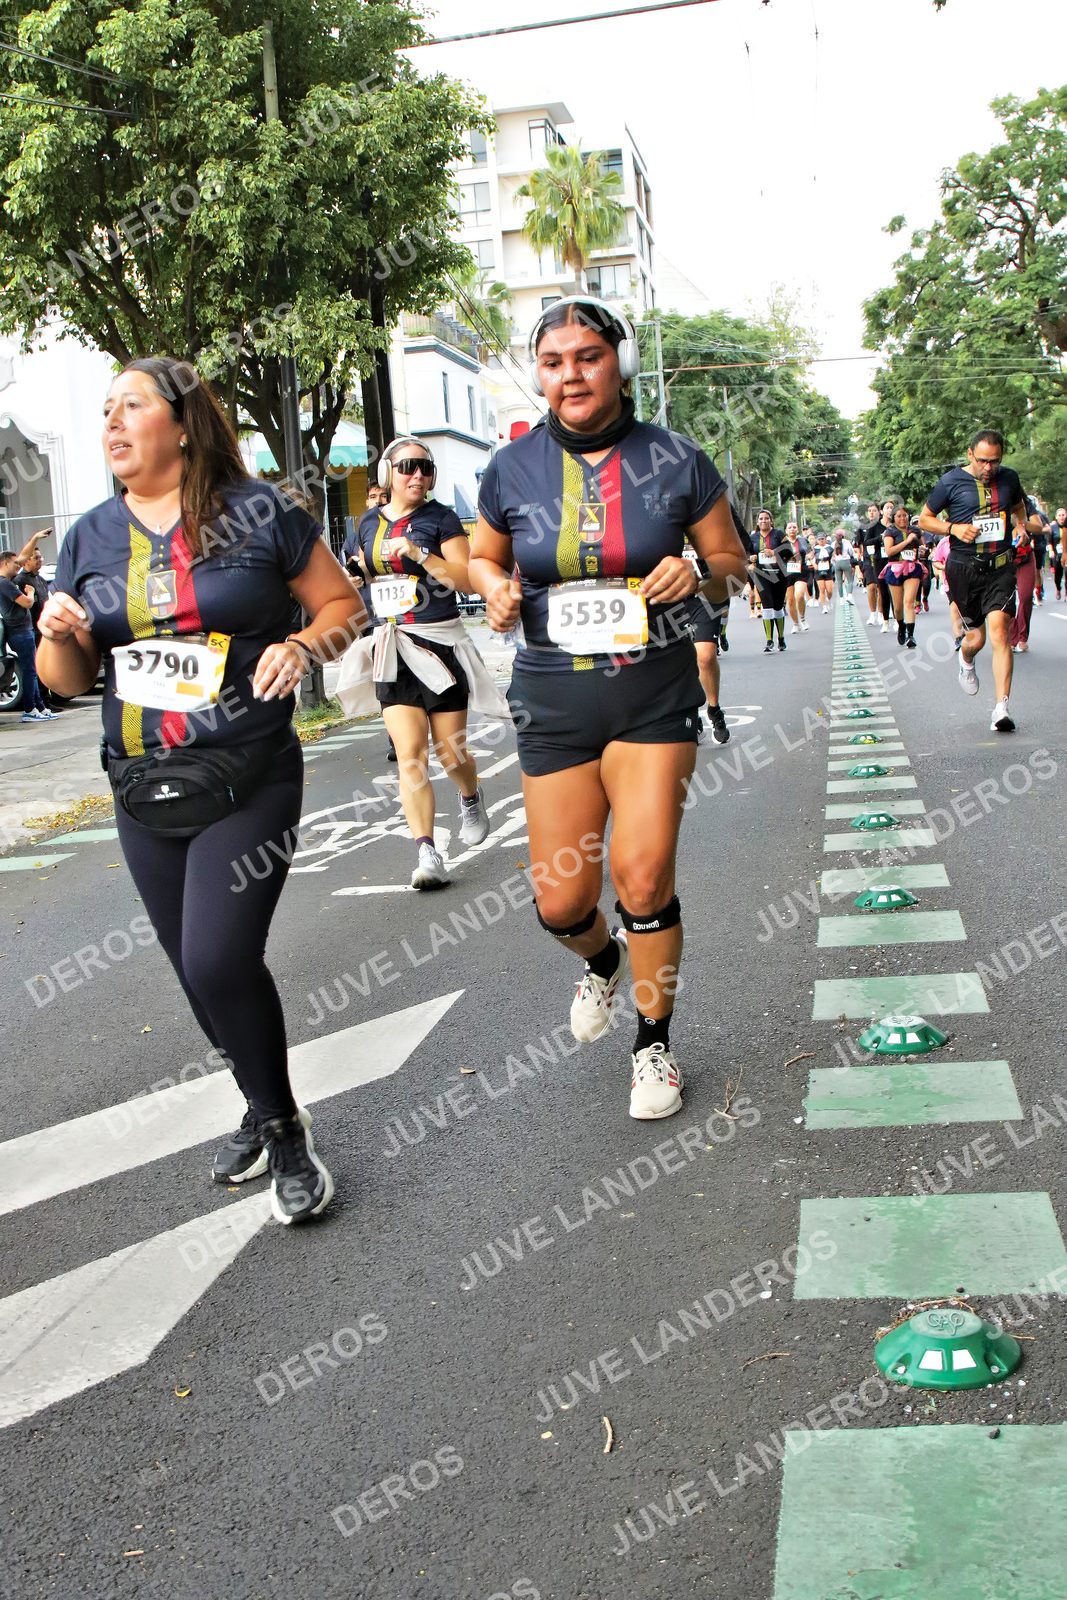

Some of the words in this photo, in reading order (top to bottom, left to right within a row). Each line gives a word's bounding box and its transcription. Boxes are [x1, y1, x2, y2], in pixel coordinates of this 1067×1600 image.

[377, 585, 405, 602] 1135
[560, 598, 626, 628] 5539
[127, 649, 199, 681] 3790
